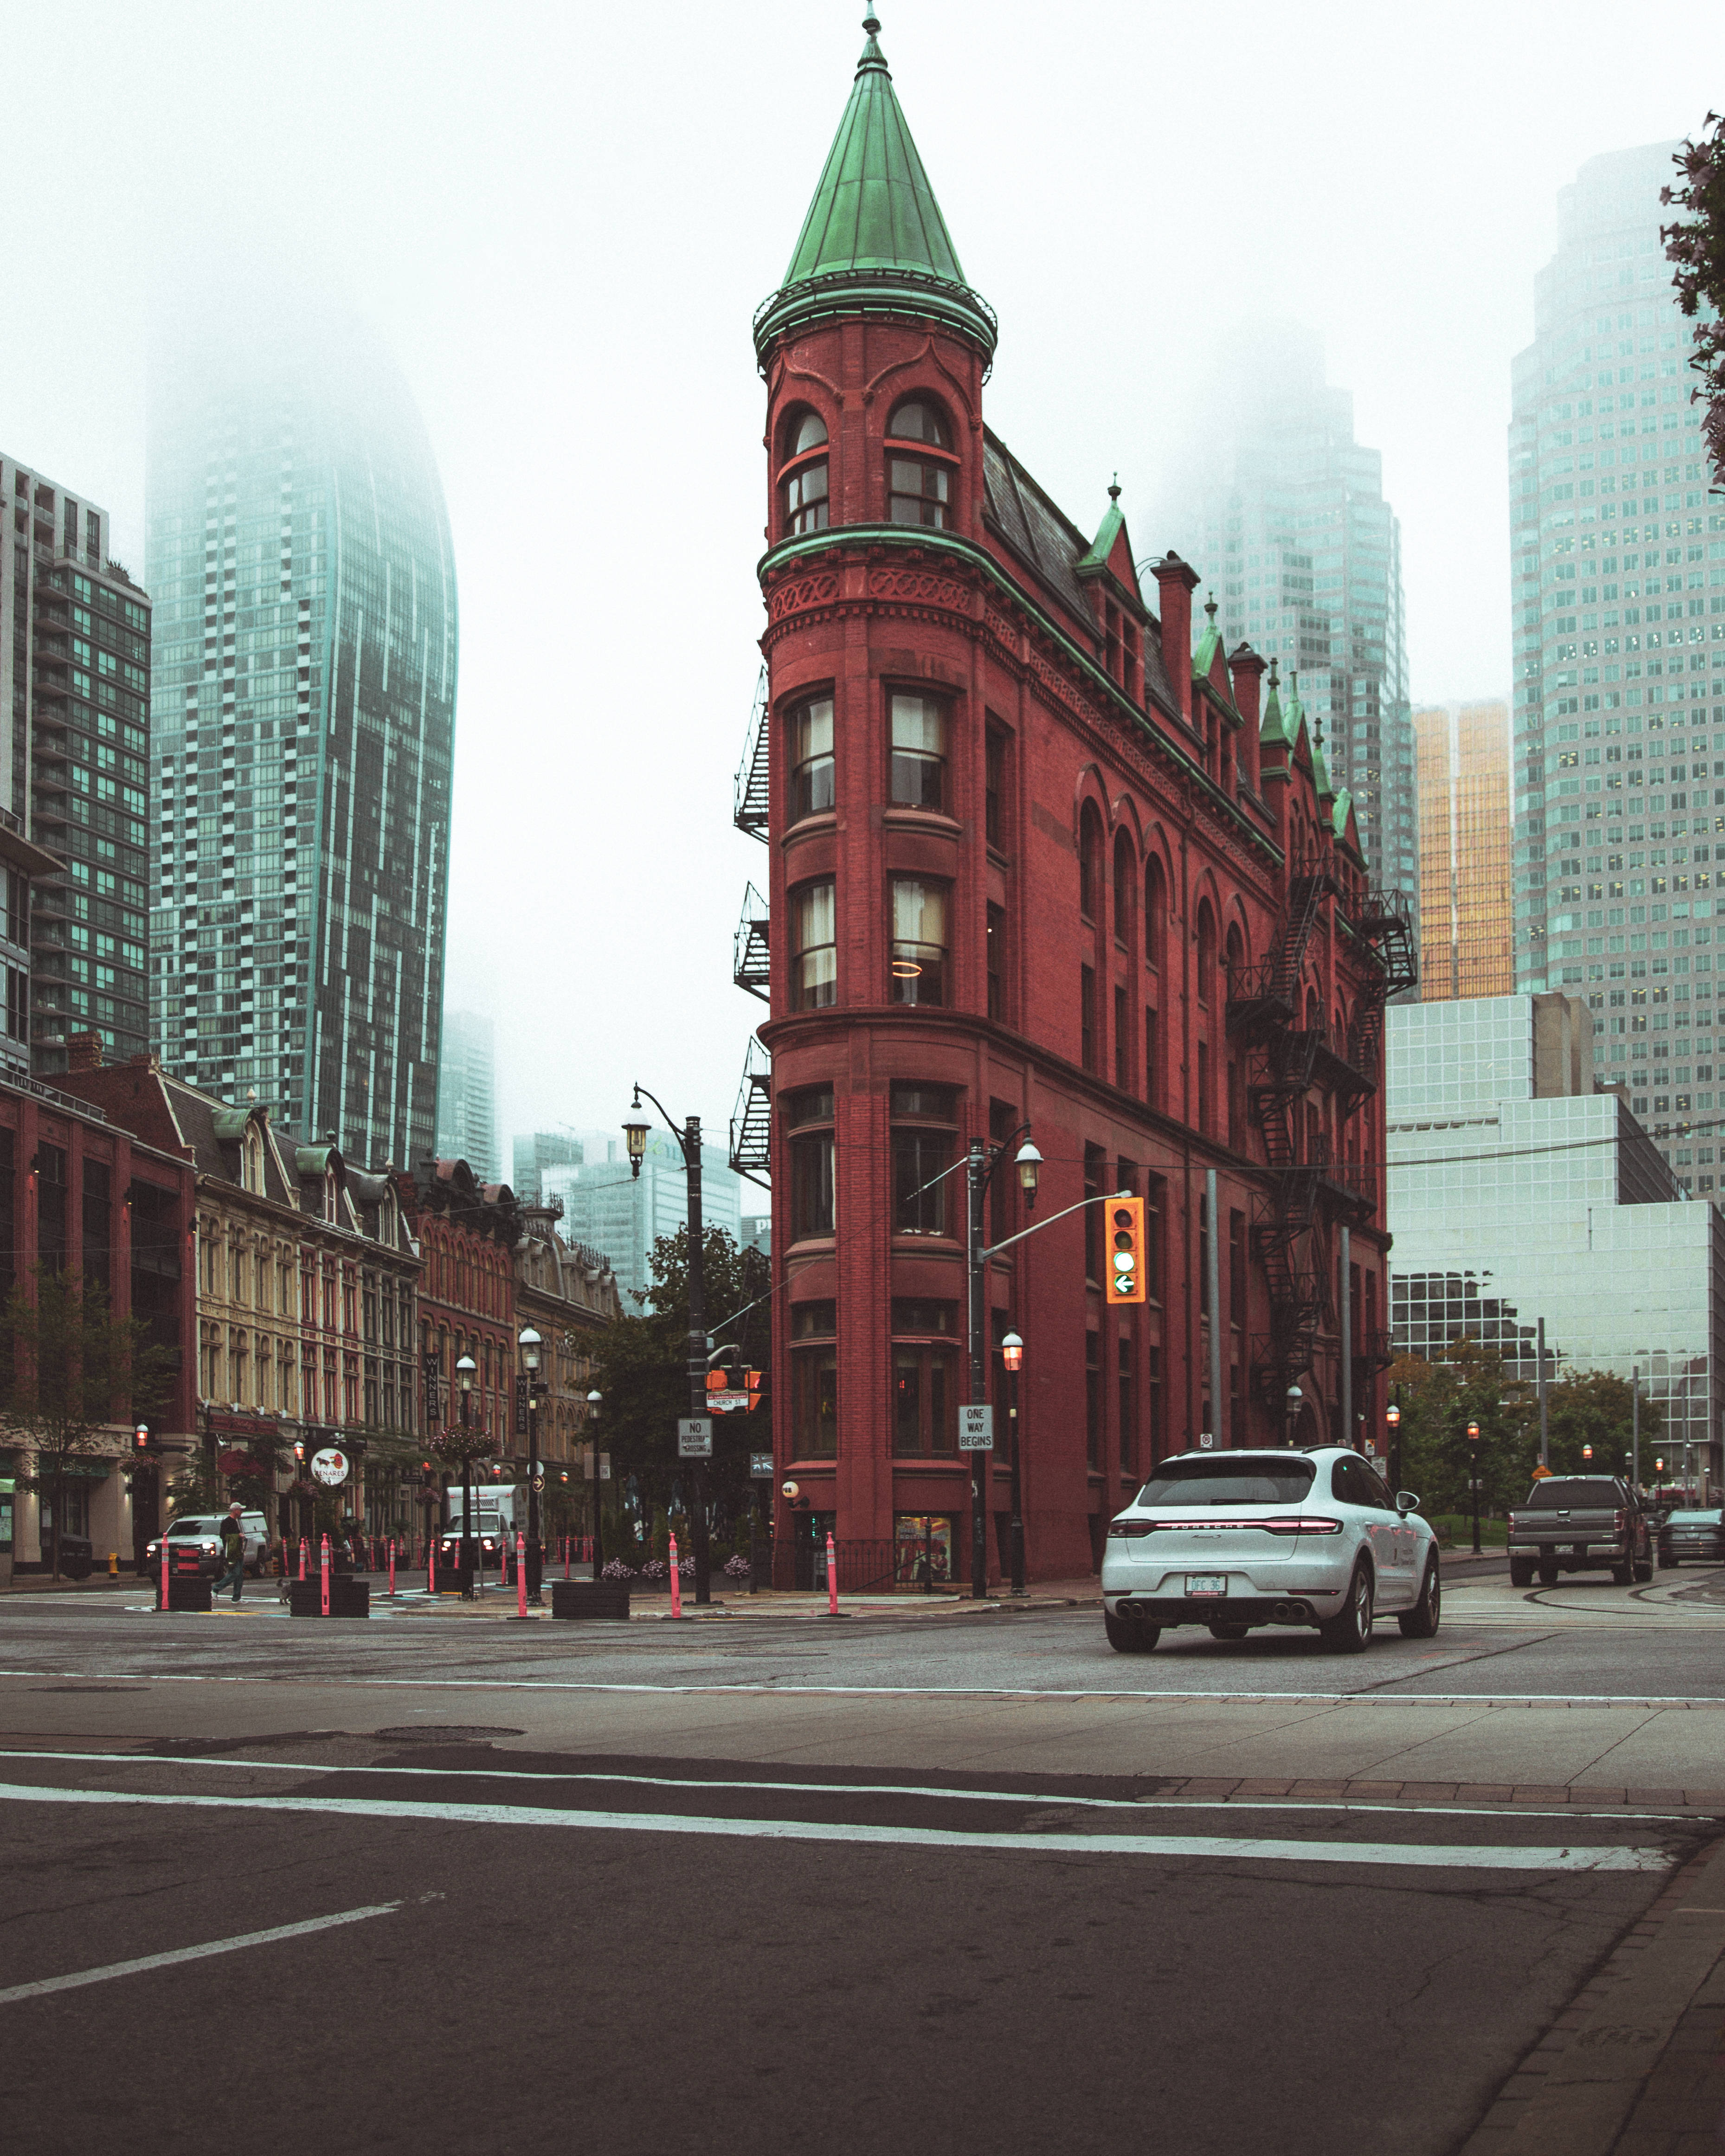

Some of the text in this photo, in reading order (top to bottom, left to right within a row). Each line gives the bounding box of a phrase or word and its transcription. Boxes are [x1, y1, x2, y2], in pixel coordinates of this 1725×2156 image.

[426, 1358, 438, 1416] WINNERS
[517, 1380, 527, 1430] WINNERS
[967, 1409, 985, 1419] ONE
[689, 1423, 702, 1433] NO
[967, 1422, 984, 1432] WAY
[961, 1435, 991, 1447] BEGINS
